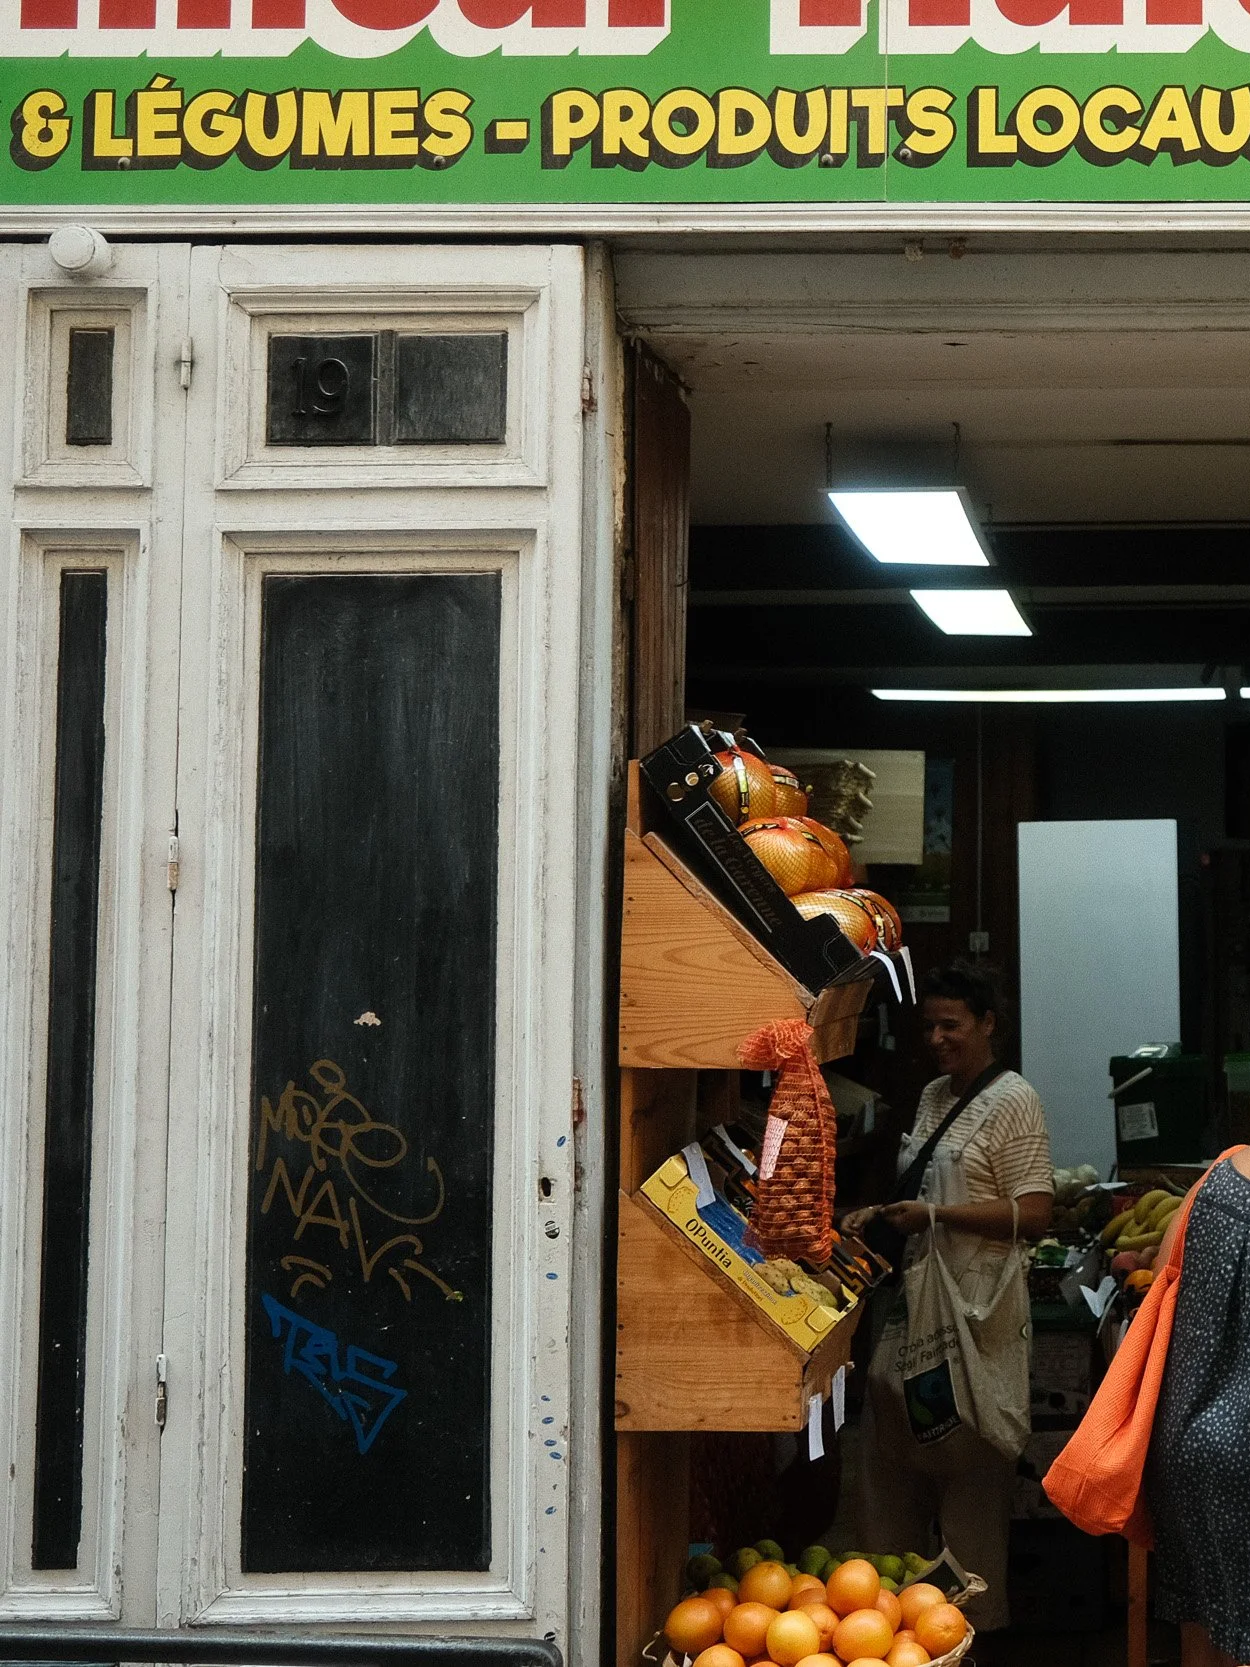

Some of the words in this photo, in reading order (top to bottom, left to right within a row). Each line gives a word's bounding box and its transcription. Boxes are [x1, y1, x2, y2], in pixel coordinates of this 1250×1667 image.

[10, 88, 70, 171] &
[81, 72, 473, 171] LÉGUMES
[542, 84, 957, 170] PRODUITS
[290, 356, 352, 418] 19
